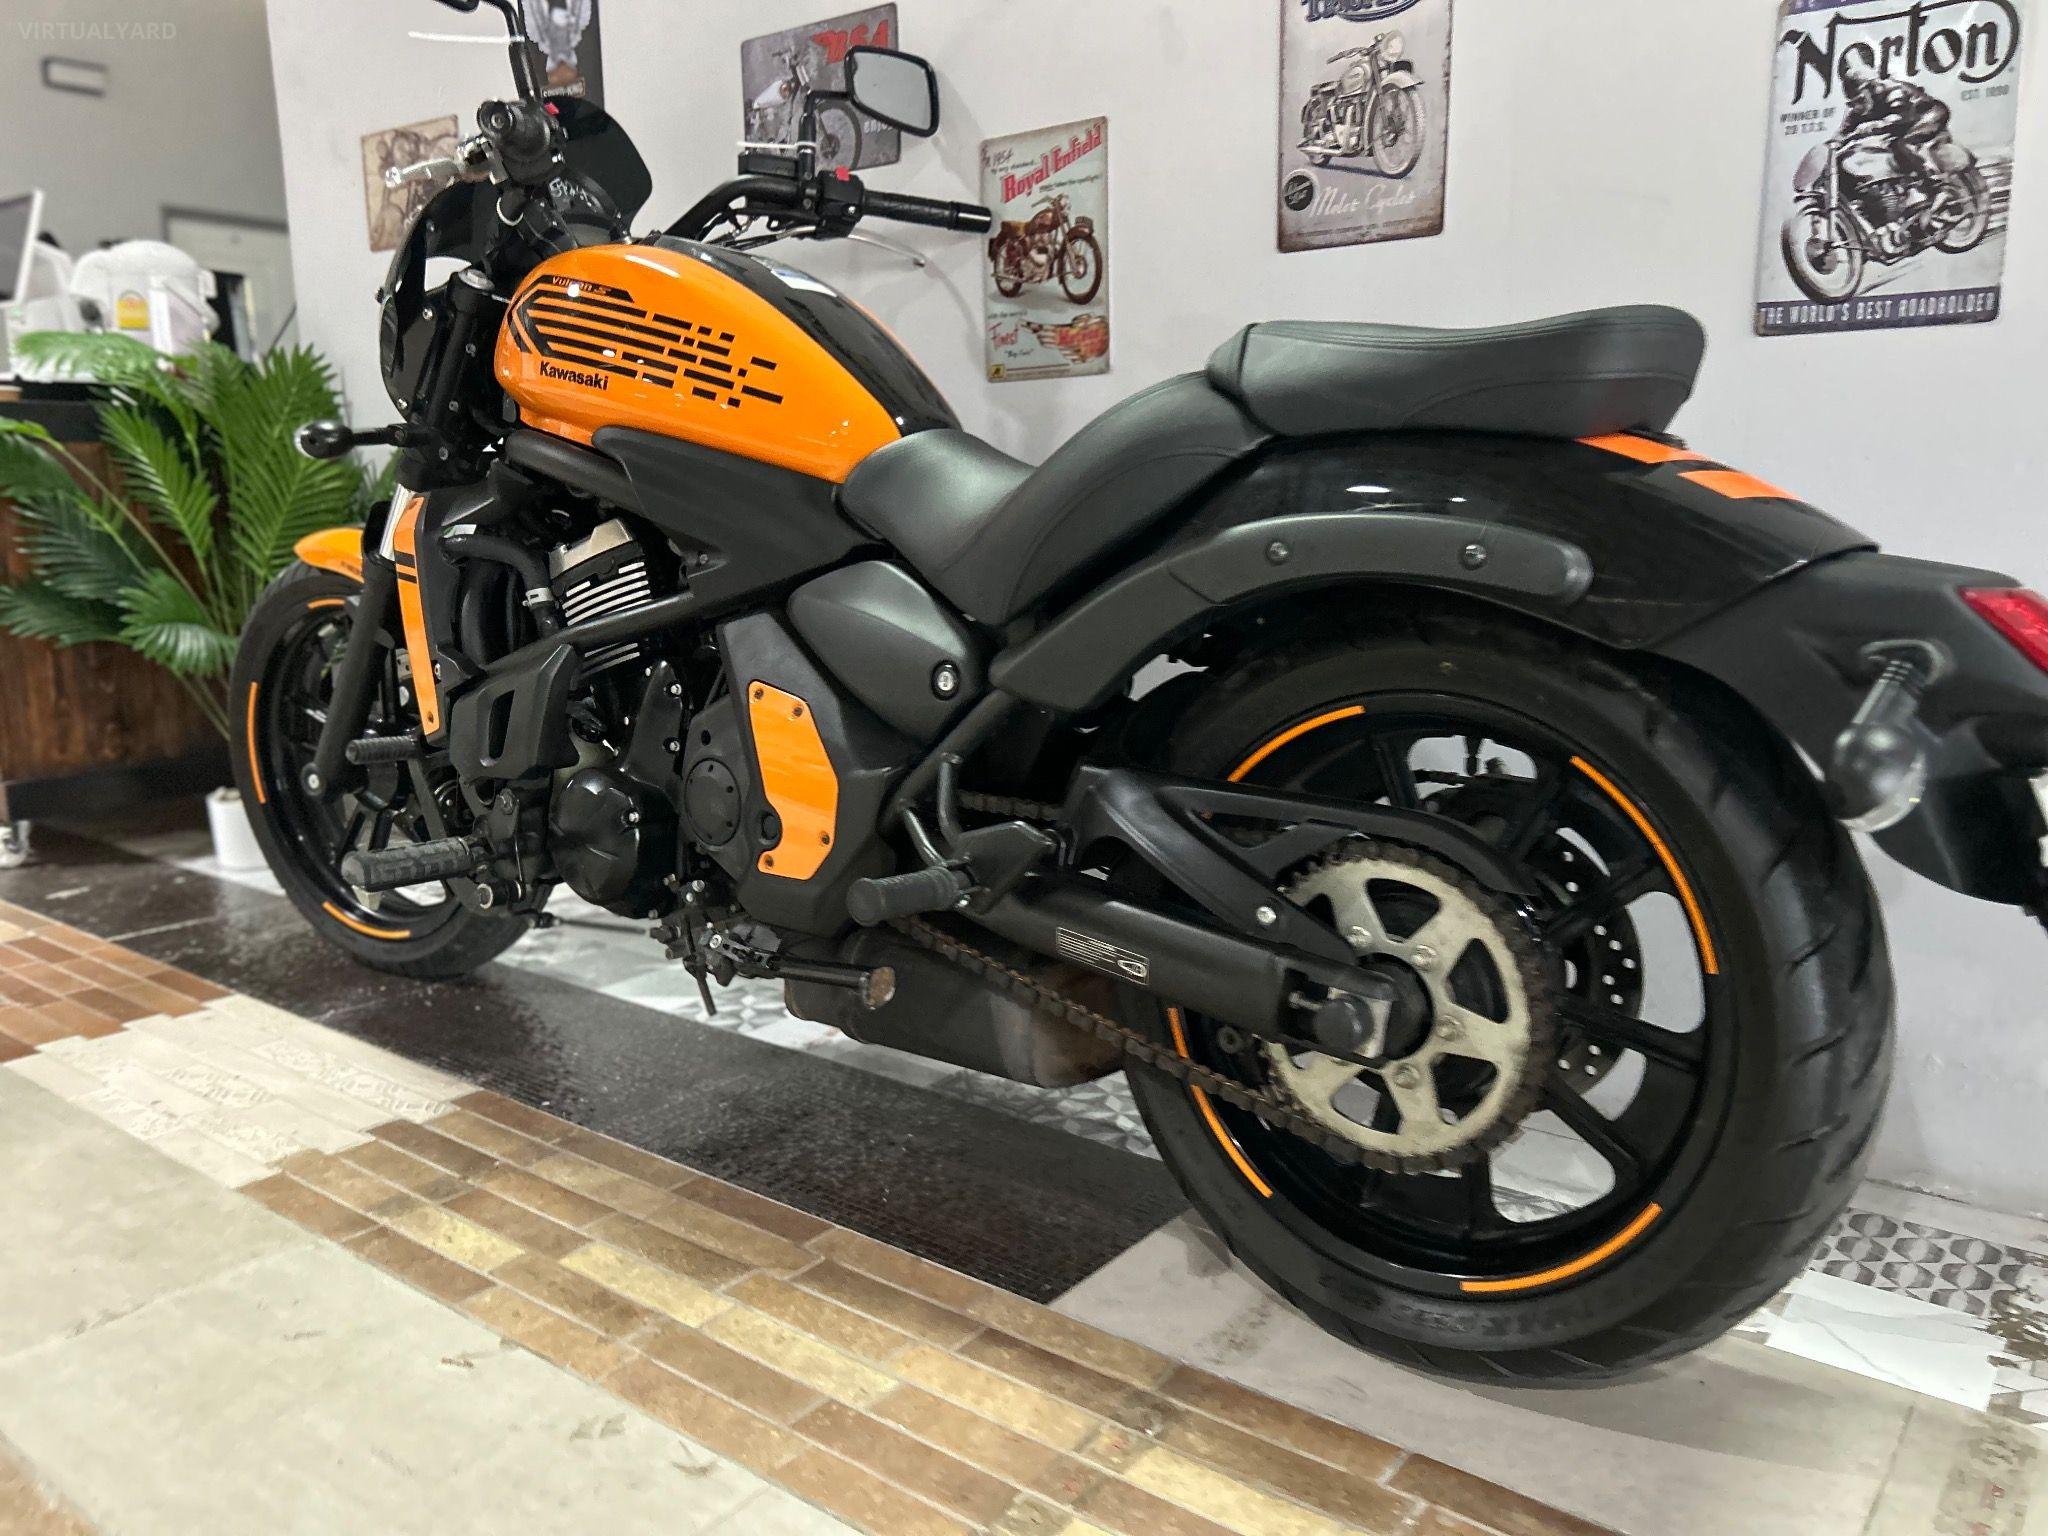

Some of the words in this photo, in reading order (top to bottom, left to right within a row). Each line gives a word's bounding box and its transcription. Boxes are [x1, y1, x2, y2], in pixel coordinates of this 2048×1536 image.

[1777, 0, 2021, 105] Norton
[1001, 152, 1051, 204] Royal
[1051, 121, 1103, 175] Enfield
[1856, 299, 1893, 320] BEST
[539, 360, 609, 391] Kawasaki
